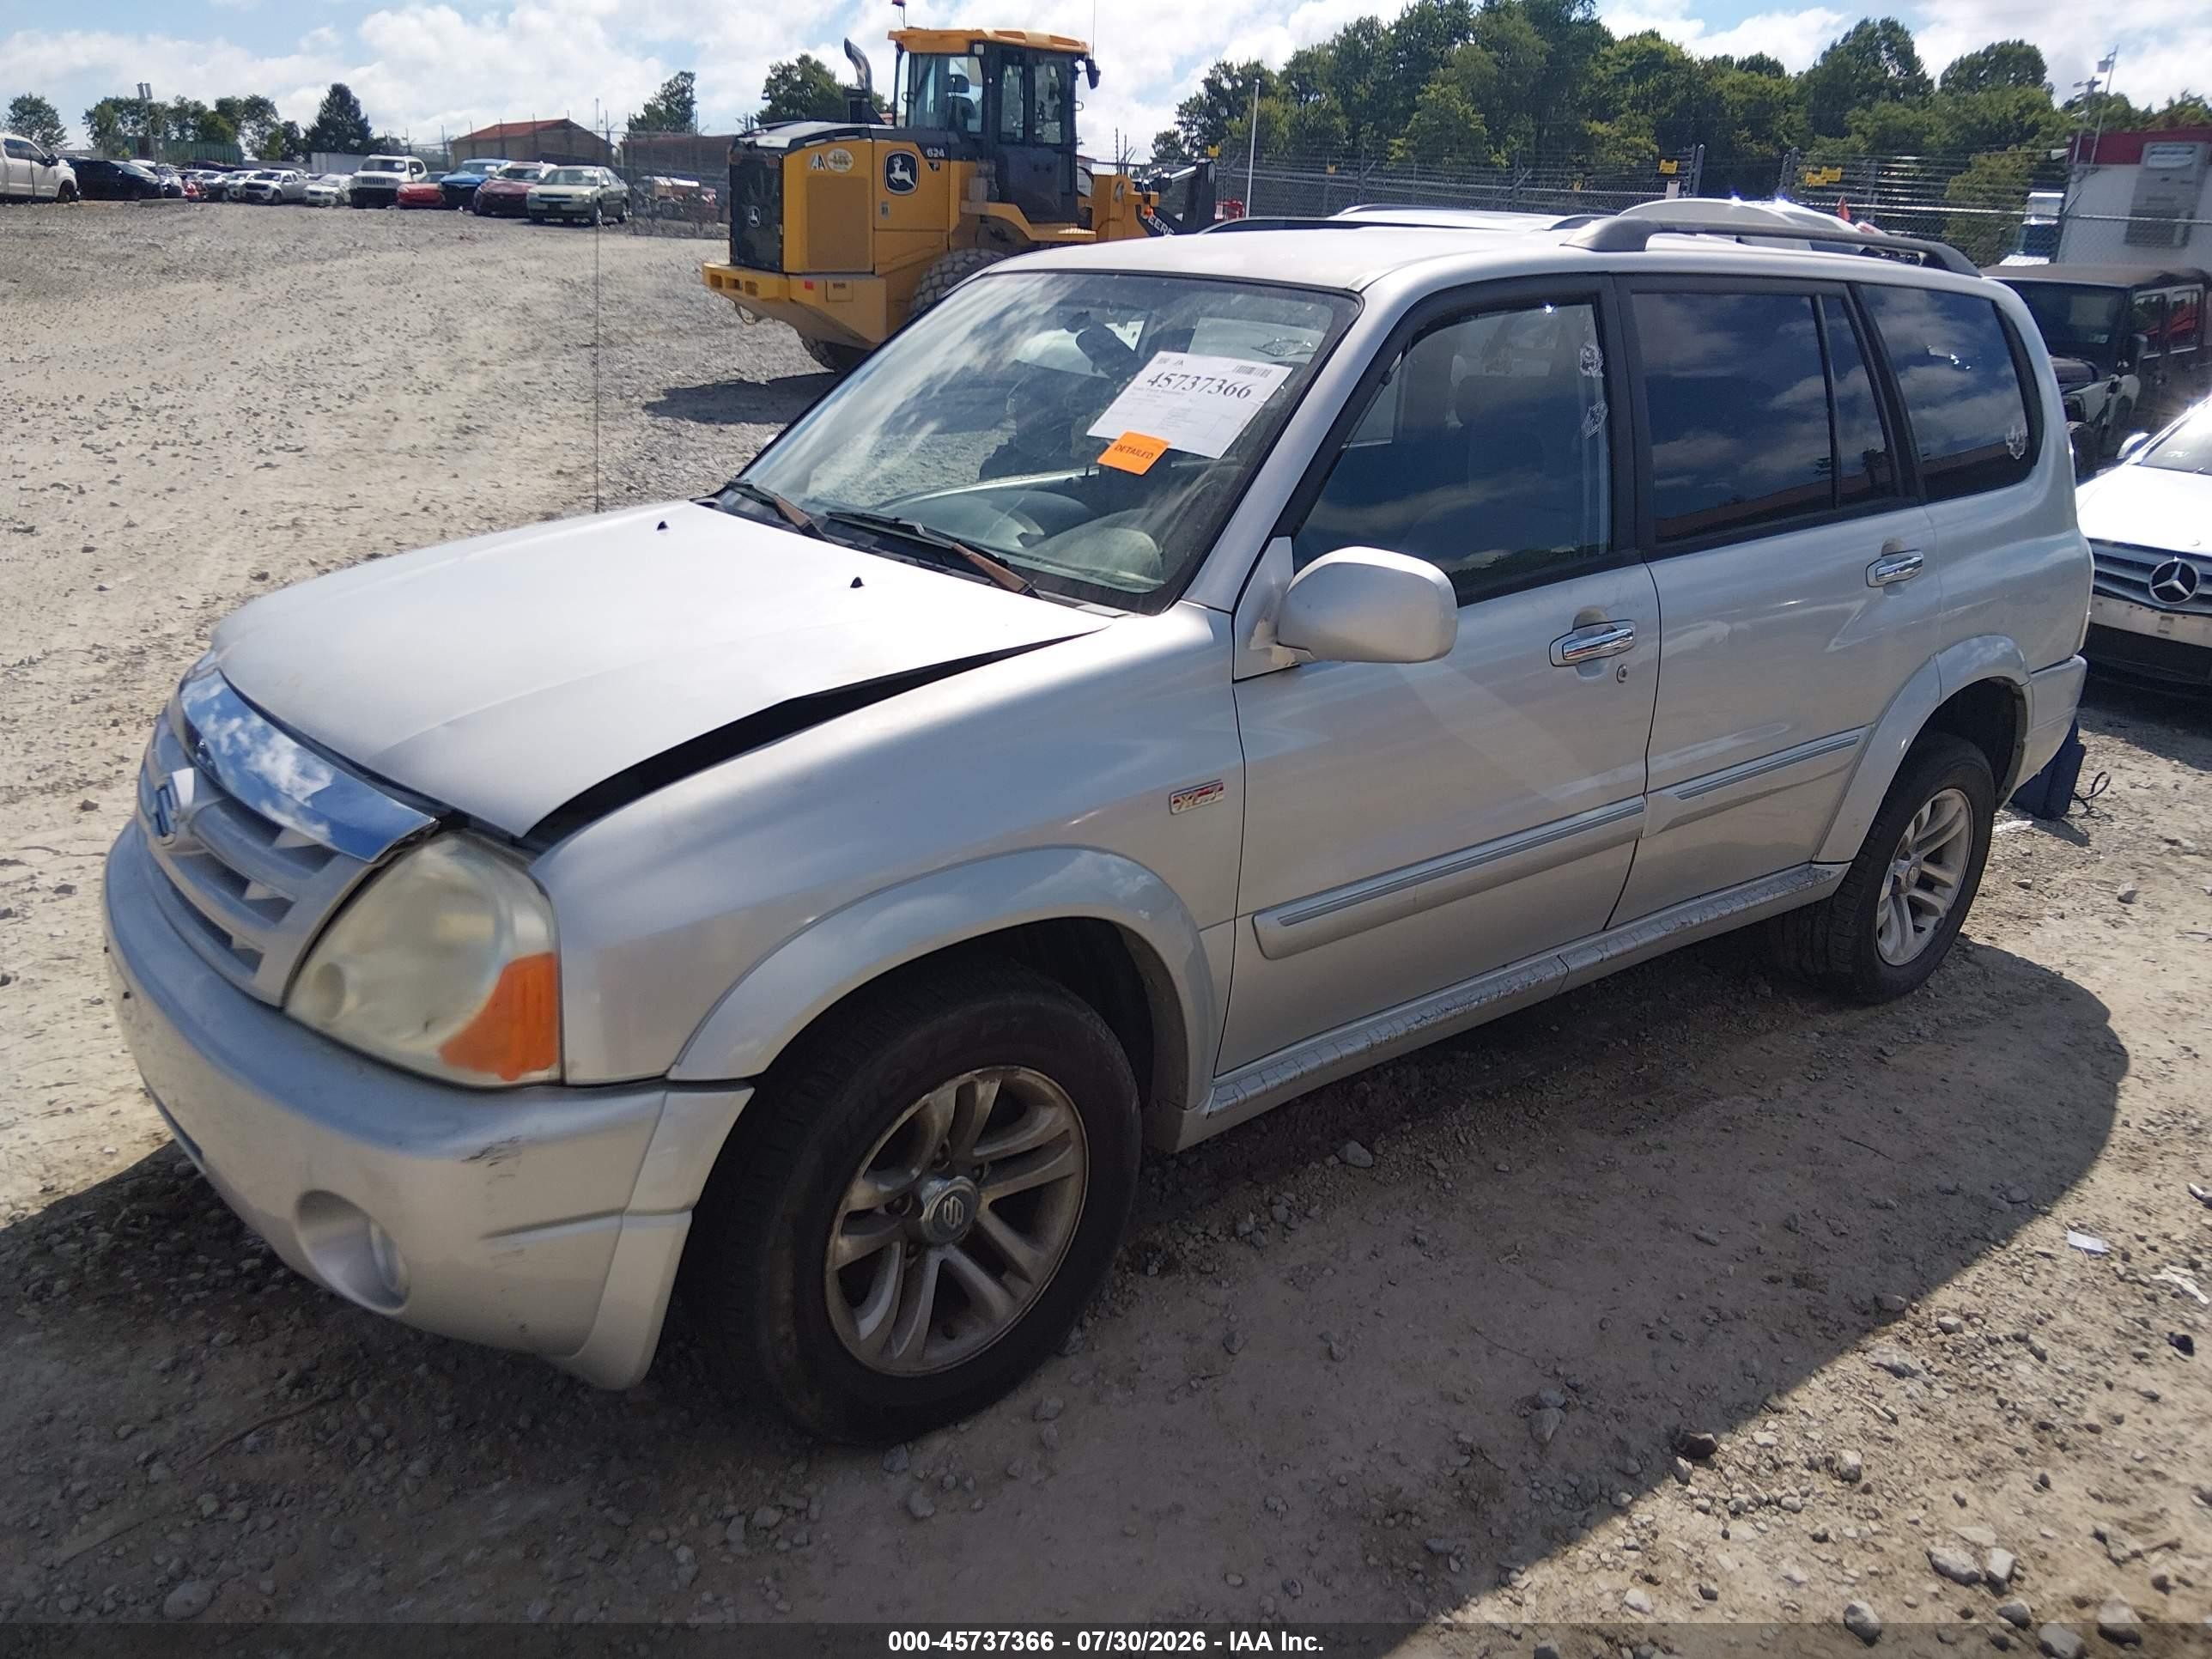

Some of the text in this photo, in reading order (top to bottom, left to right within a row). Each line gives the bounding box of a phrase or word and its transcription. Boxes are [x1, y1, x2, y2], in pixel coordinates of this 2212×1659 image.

[927, 147, 945, 157] 624
[1147, 371, 1255, 399] 45737366
[1115, 445, 1154, 459] DETAILED
